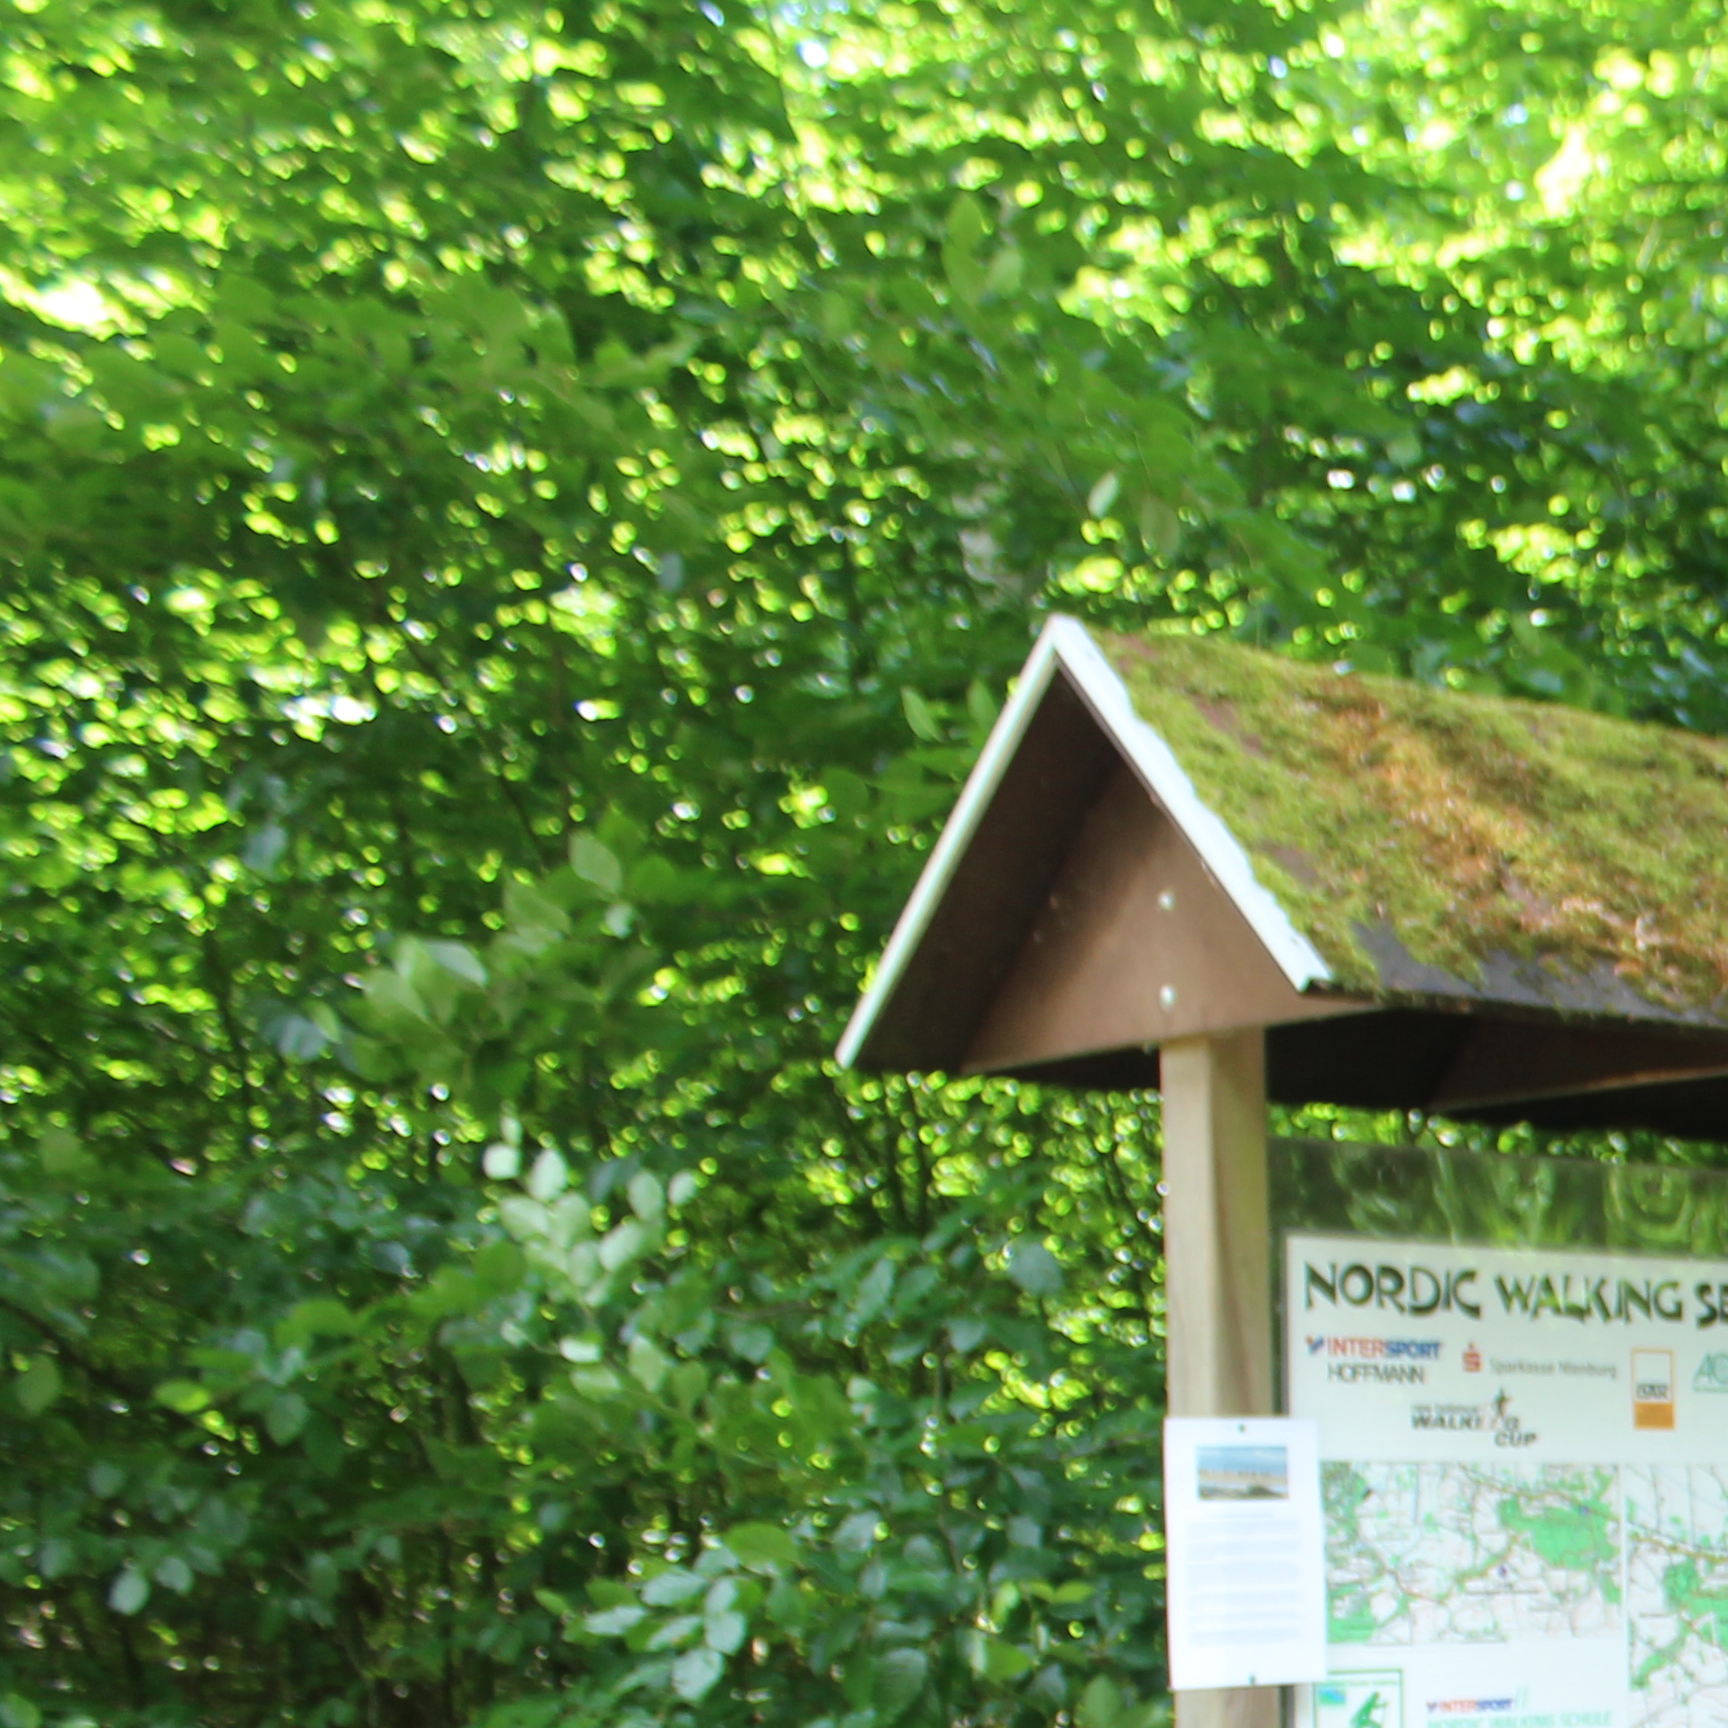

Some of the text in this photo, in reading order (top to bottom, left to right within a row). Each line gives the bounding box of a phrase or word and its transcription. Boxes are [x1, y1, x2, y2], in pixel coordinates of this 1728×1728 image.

[1305, 1261, 1481, 1320] NORDIC
[1495, 1272, 1683, 1324] WALKING
[1327, 1337, 1441, 1359] INTERSPORT
[1327, 1363, 1425, 1384] HOFFMANN
[1494, 1431, 1537, 1448] CUP
